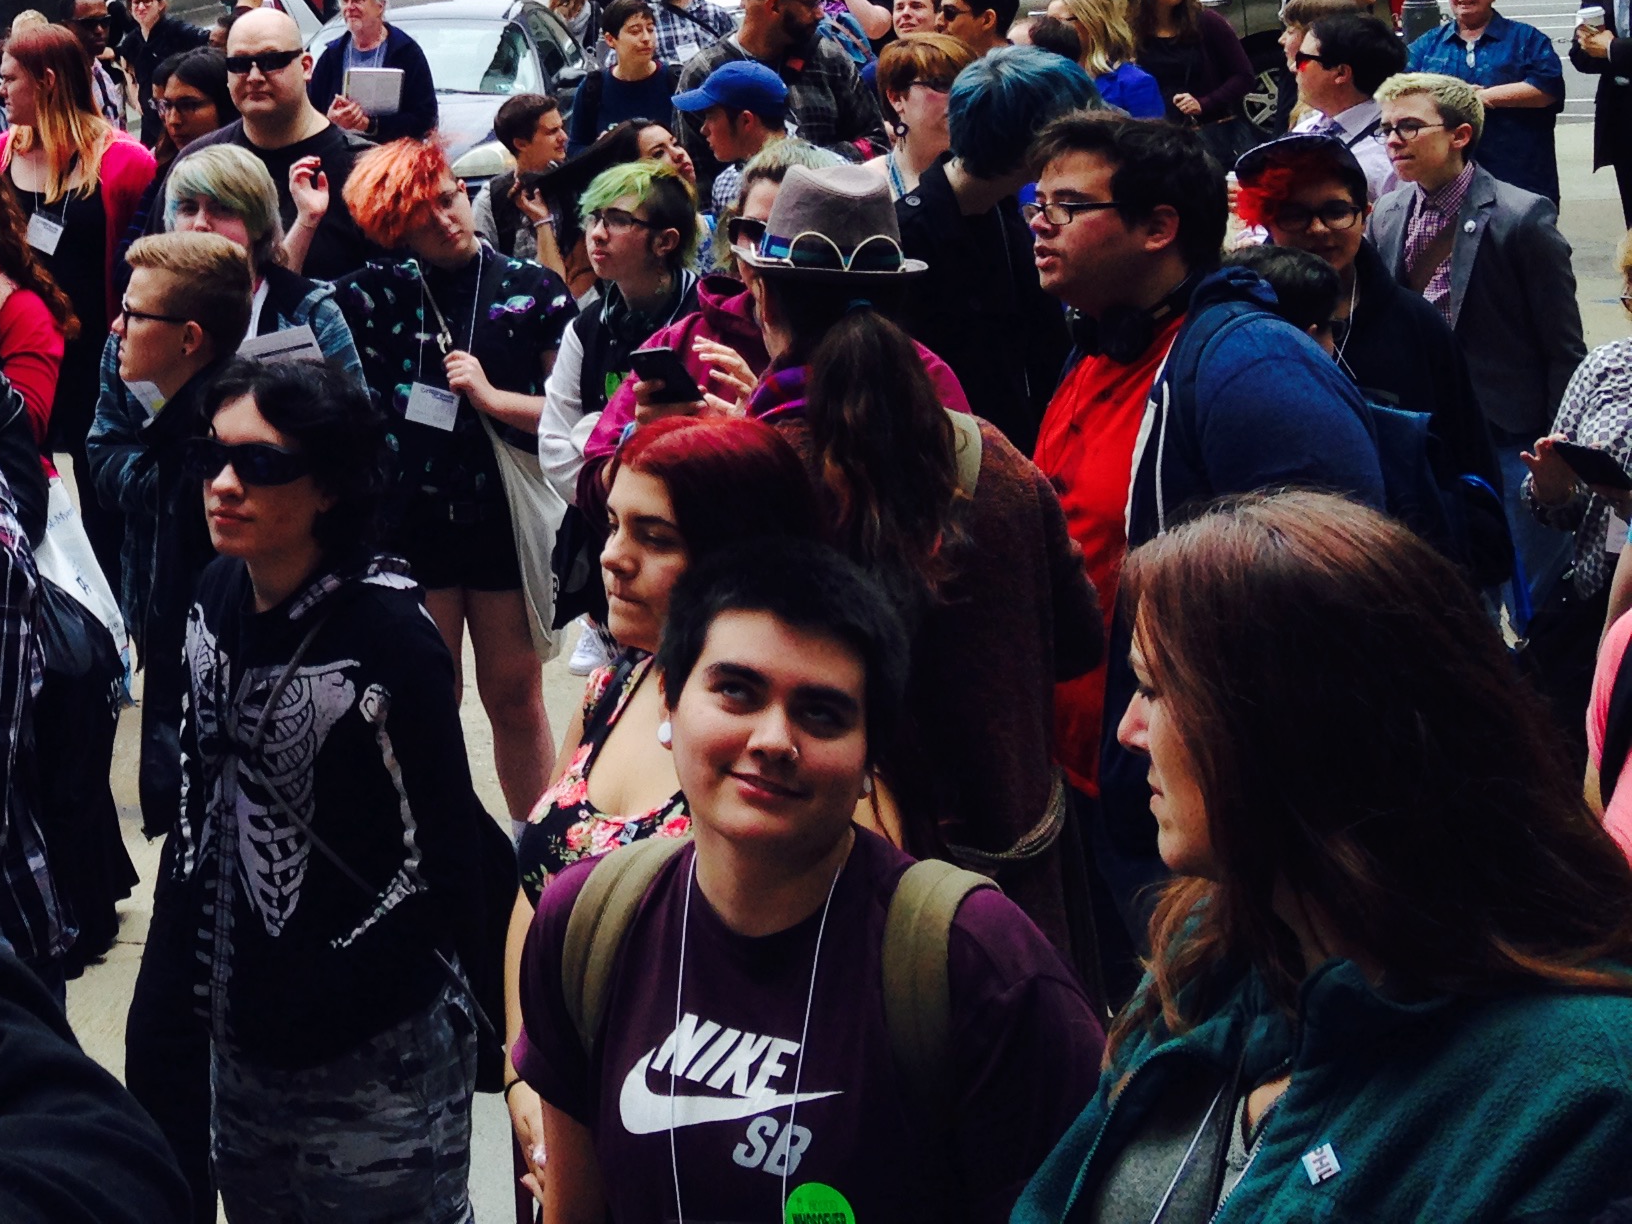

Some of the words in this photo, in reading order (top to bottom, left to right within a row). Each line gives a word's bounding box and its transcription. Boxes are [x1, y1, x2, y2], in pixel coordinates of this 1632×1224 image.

[651, 1013, 801, 1101] NIKE
[732, 1115, 813, 1176] SB
[1312, 1146, 1333, 1180] PHL
